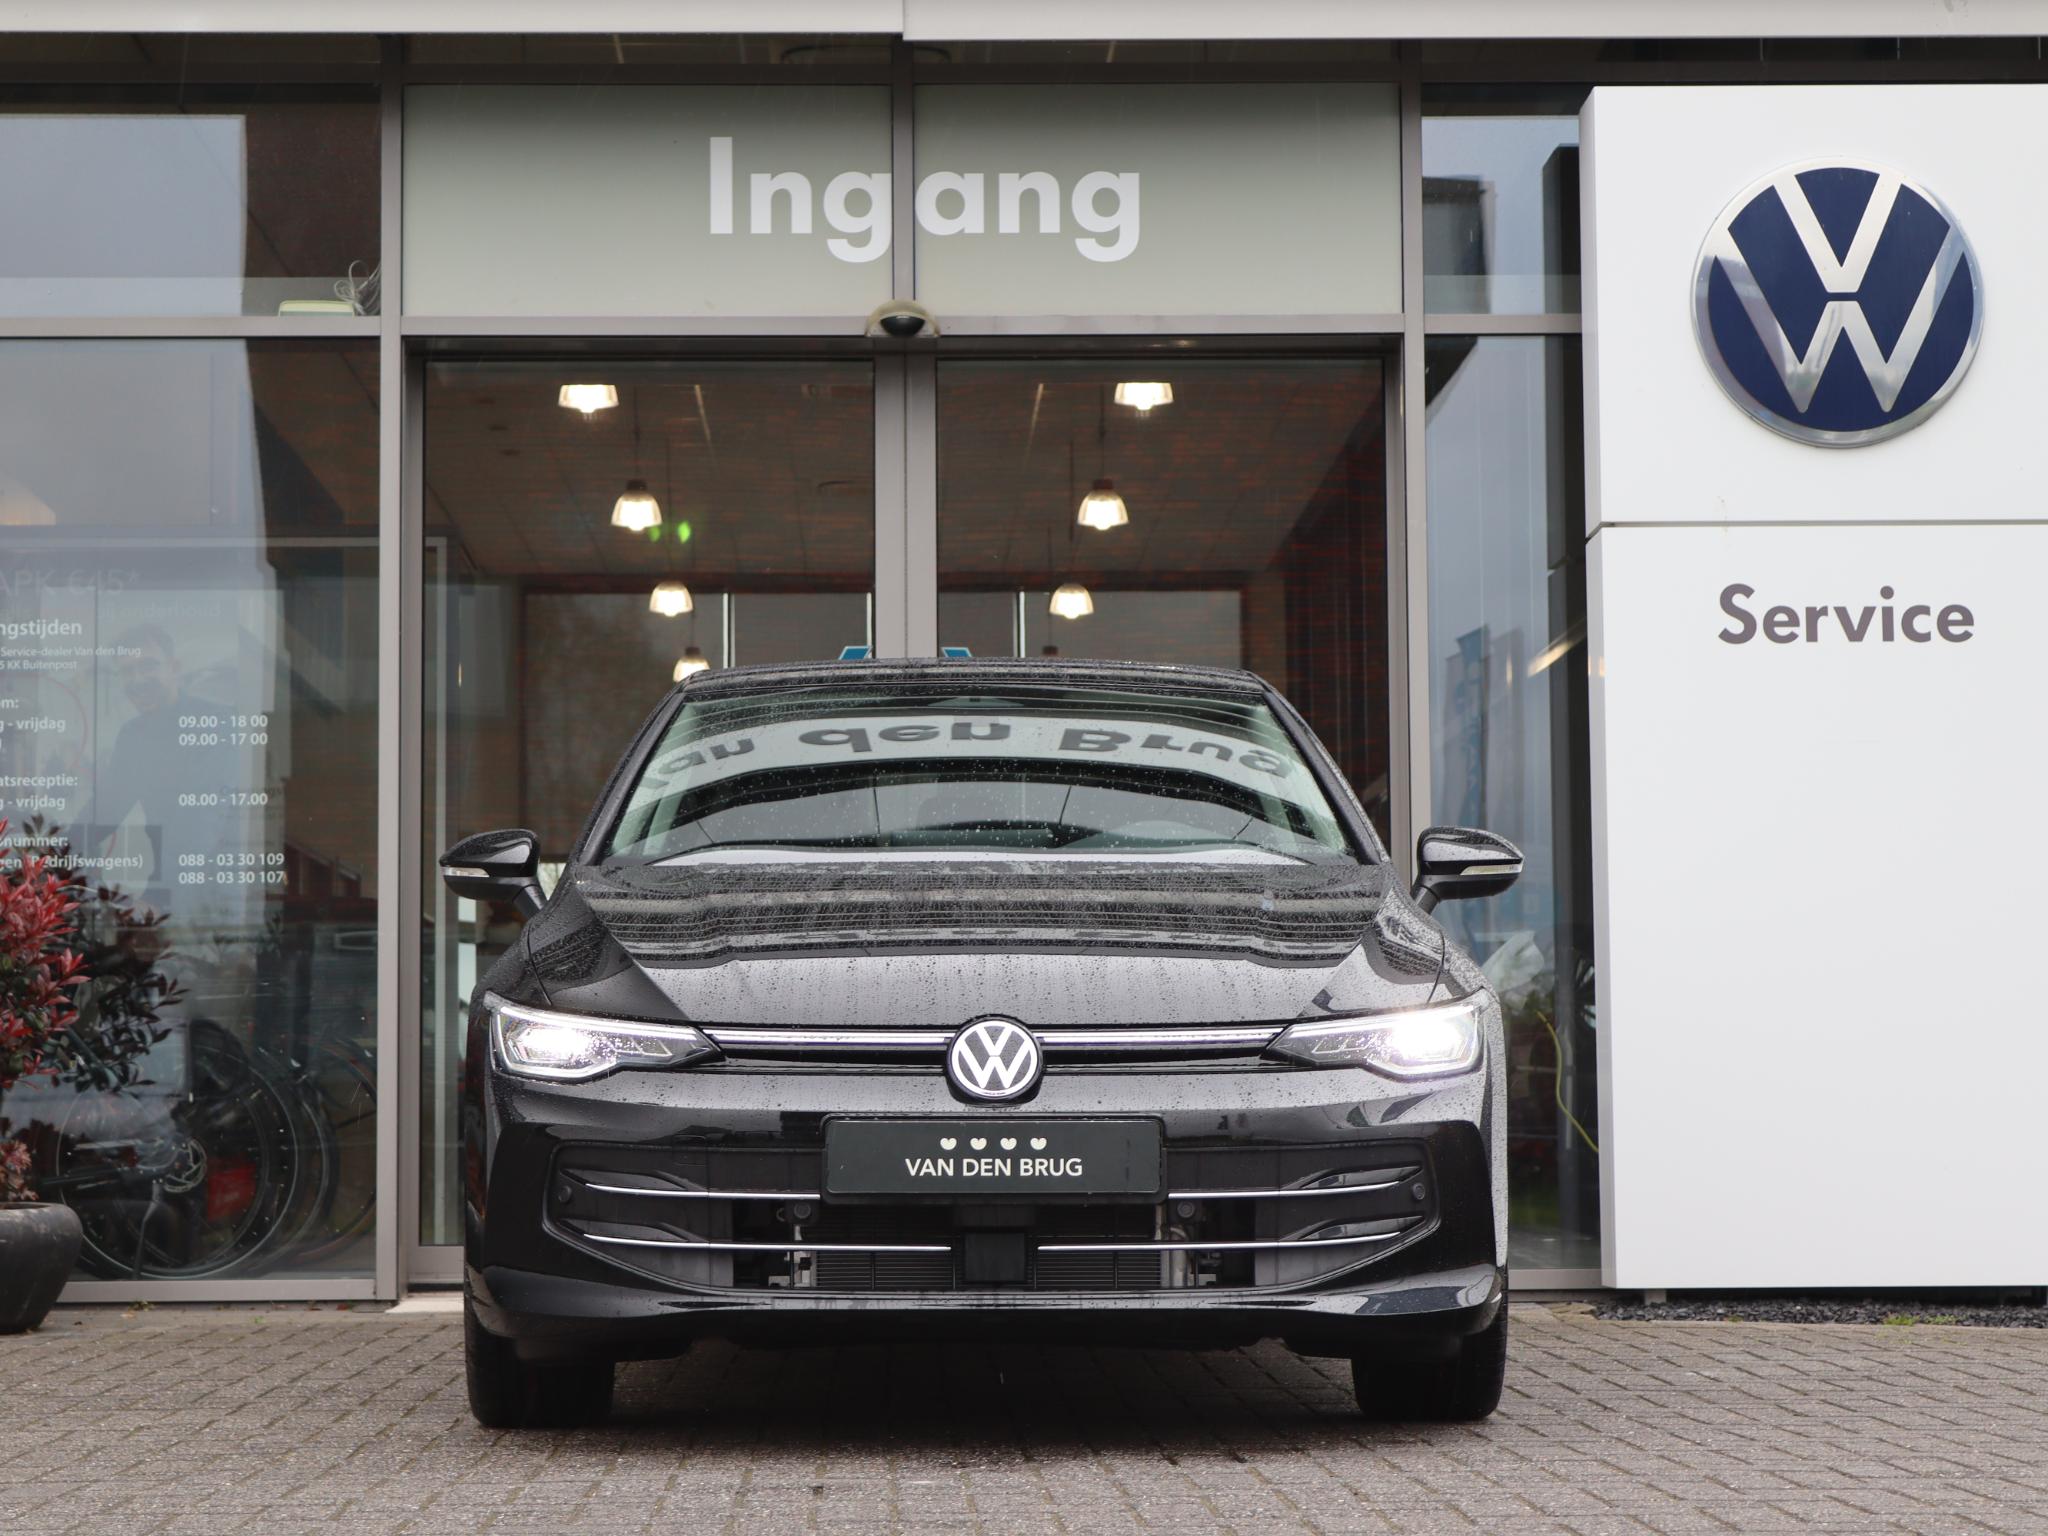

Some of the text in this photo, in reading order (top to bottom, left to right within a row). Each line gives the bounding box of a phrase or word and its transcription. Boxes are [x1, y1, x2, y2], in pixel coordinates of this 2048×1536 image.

[710, 136, 1140, 263] Ingang
[1717, 582, 1975, 645] Service
[16, 716, 66, 732] vrijdag
[178, 716, 218, 728] 09.00
[178, 733, 218, 746] 09.00
[16, 794, 66, 810] vrijdag
[178, 794, 218, 806] 08.00
[230, 793, 268, 806] 17.00
[178, 854, 205, 867] 088
[216, 854, 233, 866] 03
[237, 854, 255, 866] 30
[259, 853, 285, 866] 109
[178, 872, 205, 885] 088
[216, 872, 233, 884] 03
[237, 872, 255, 884] 30
[259, 871, 284, 884] 107
[905, 1157, 1083, 1177] VAN DEN BRUG
